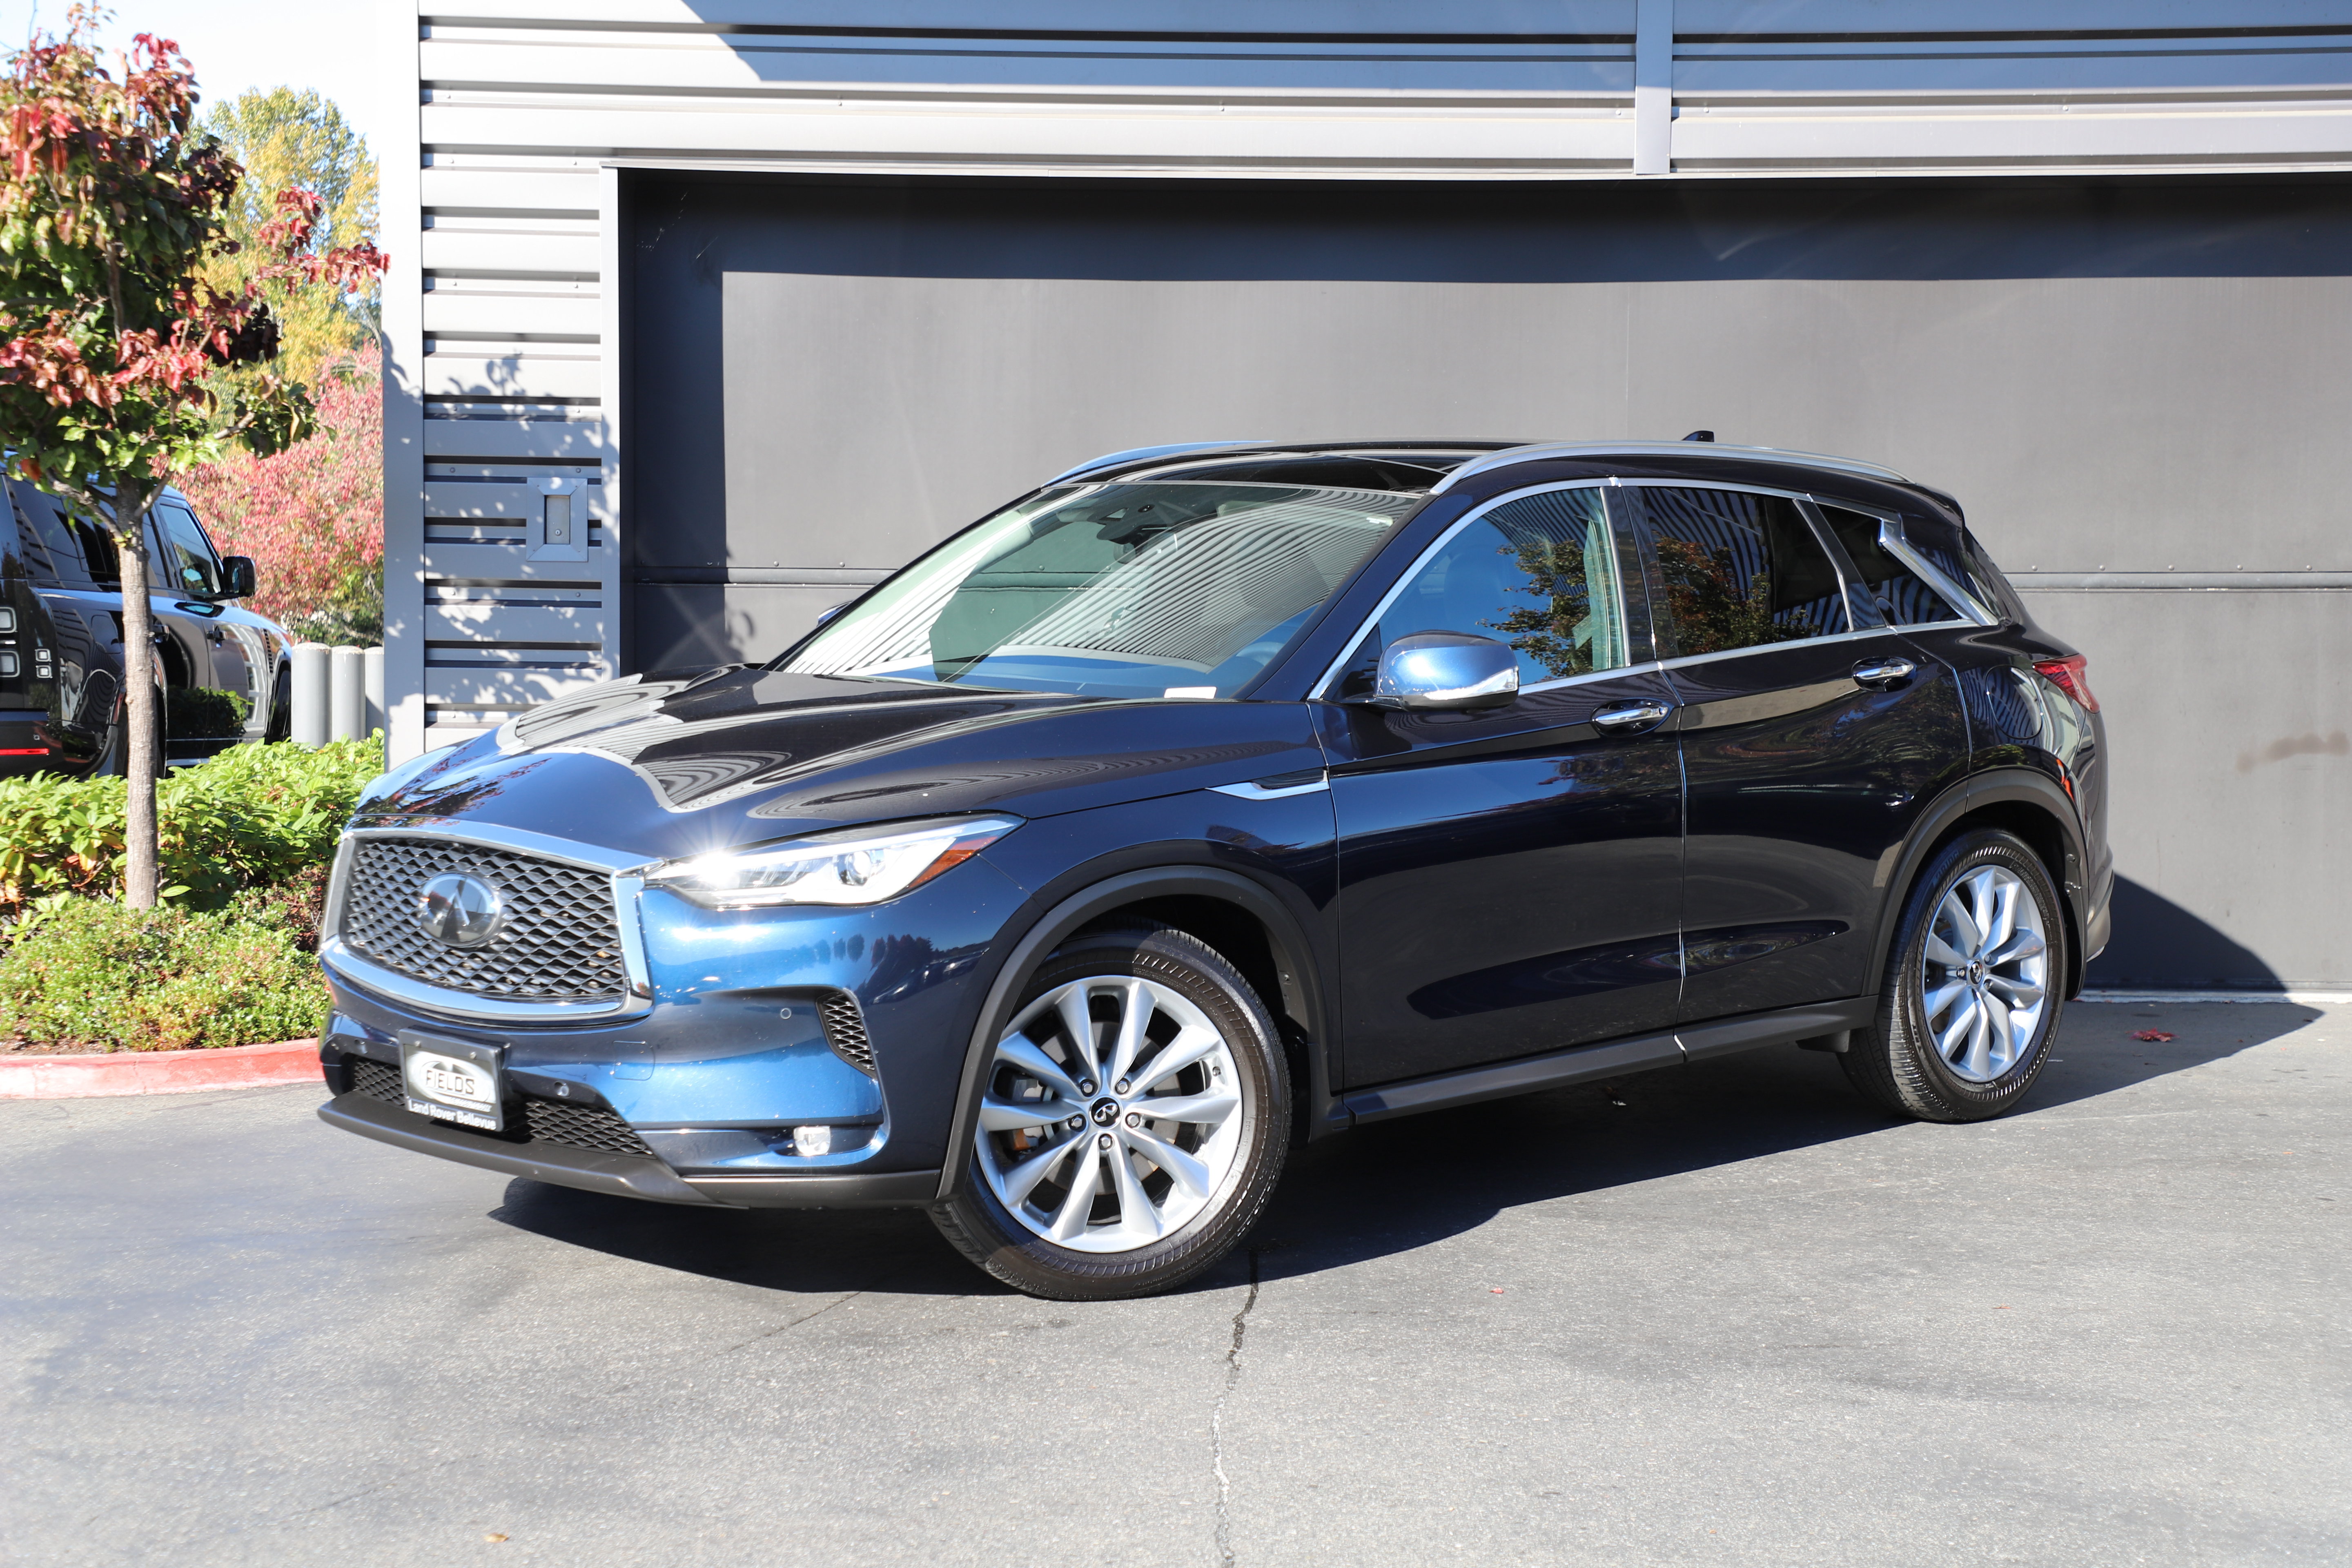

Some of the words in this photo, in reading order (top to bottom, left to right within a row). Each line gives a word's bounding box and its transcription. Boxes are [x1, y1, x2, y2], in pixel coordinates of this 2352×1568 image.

[426, 1069, 474, 1095] FIELDS
[409, 1099, 429, 1115] Land
[430, 1104, 455, 1121] Rover
[456, 1110, 496, 1130] Bellevue
